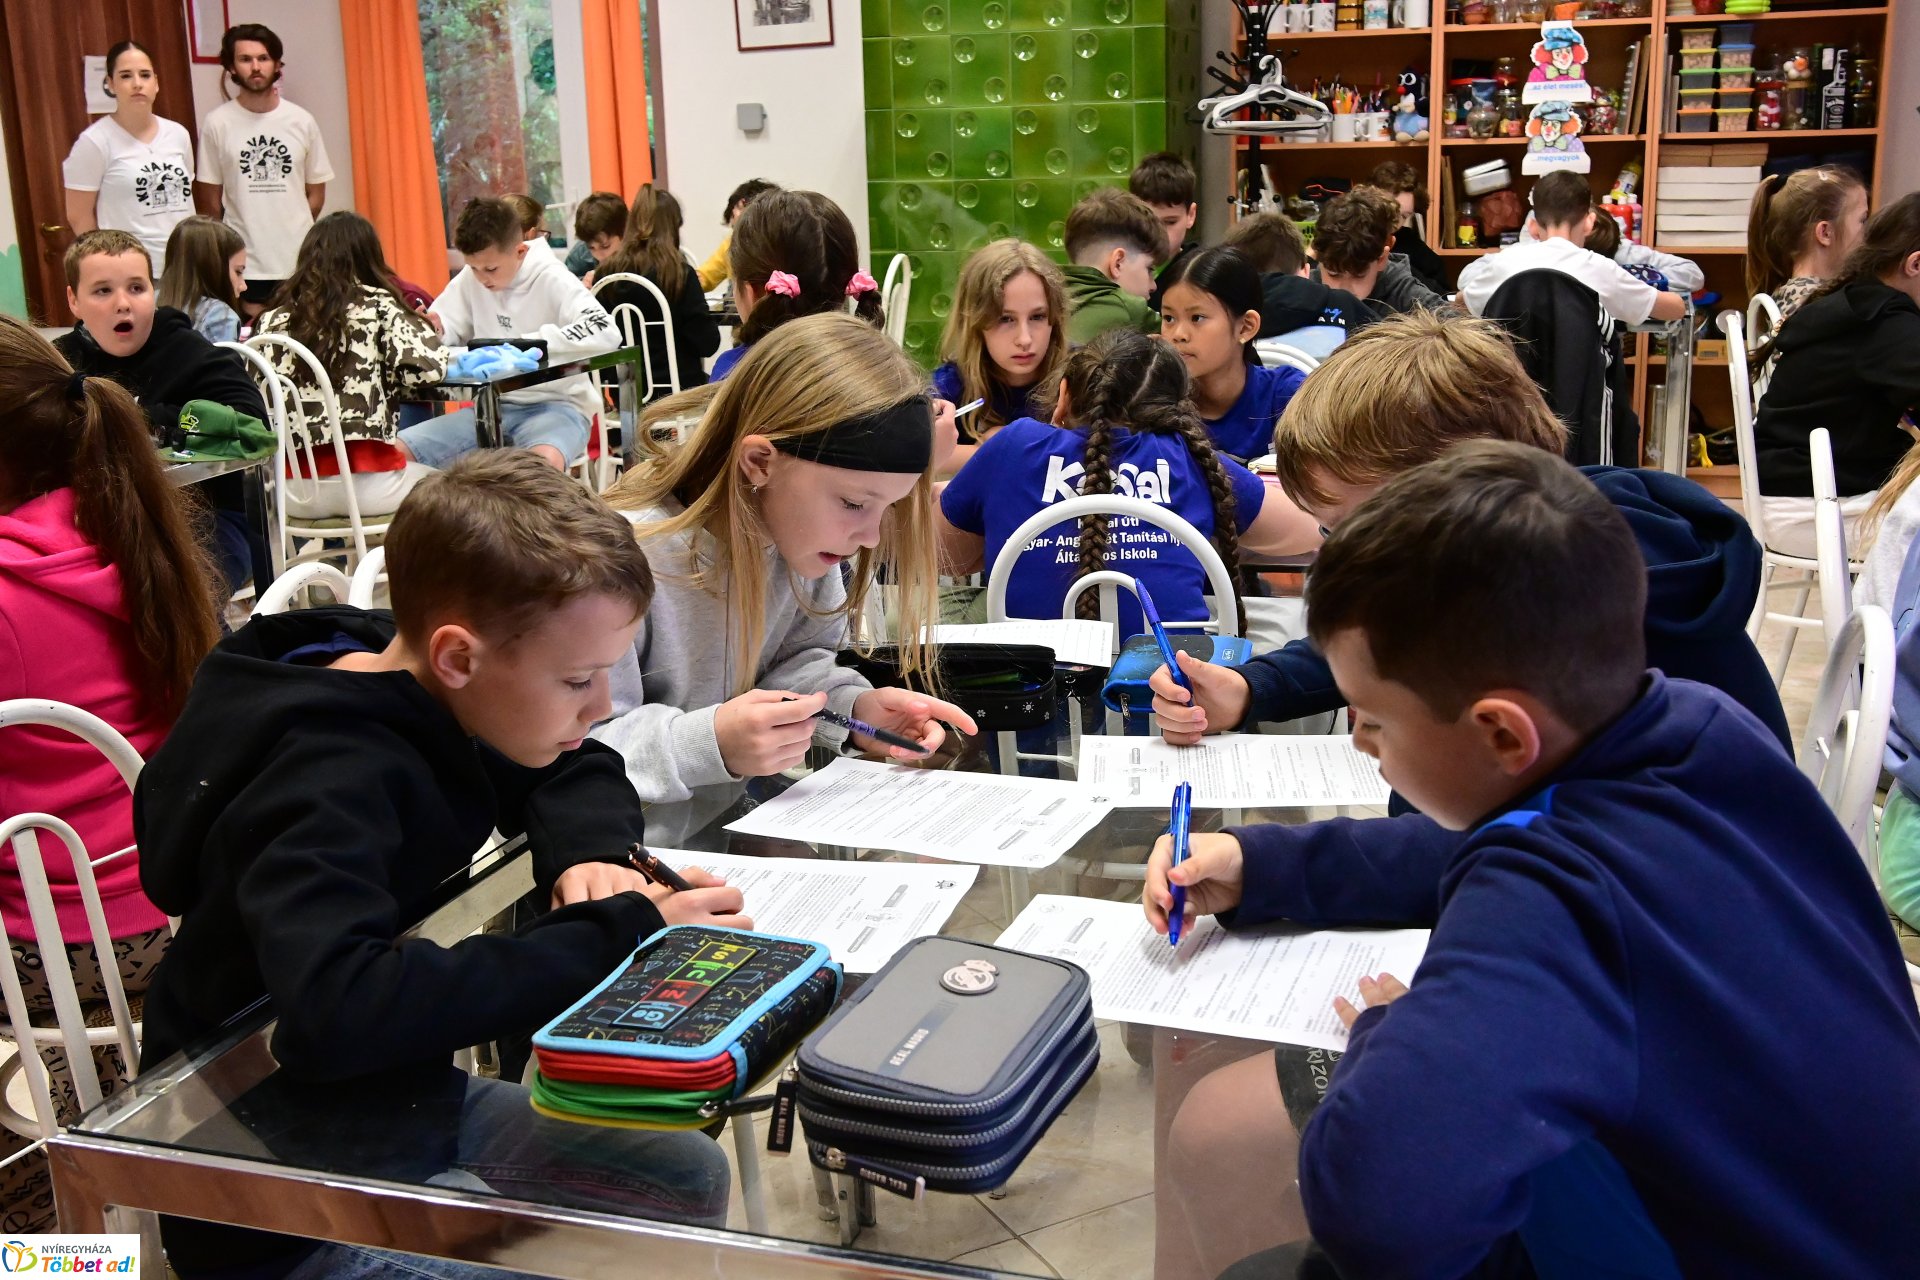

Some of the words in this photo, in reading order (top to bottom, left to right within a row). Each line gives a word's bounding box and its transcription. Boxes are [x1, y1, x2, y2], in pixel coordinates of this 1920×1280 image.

[239, 150, 251, 174] KIS
[247, 134, 292, 174] VAKOND
[140, 161, 192, 197] VAKOND
[136, 177, 149, 203] KIS
[1055, 534, 1083, 548] Ang
[1120, 547, 1158, 560] Iskola
[889, 1049, 912, 1066] REAL
